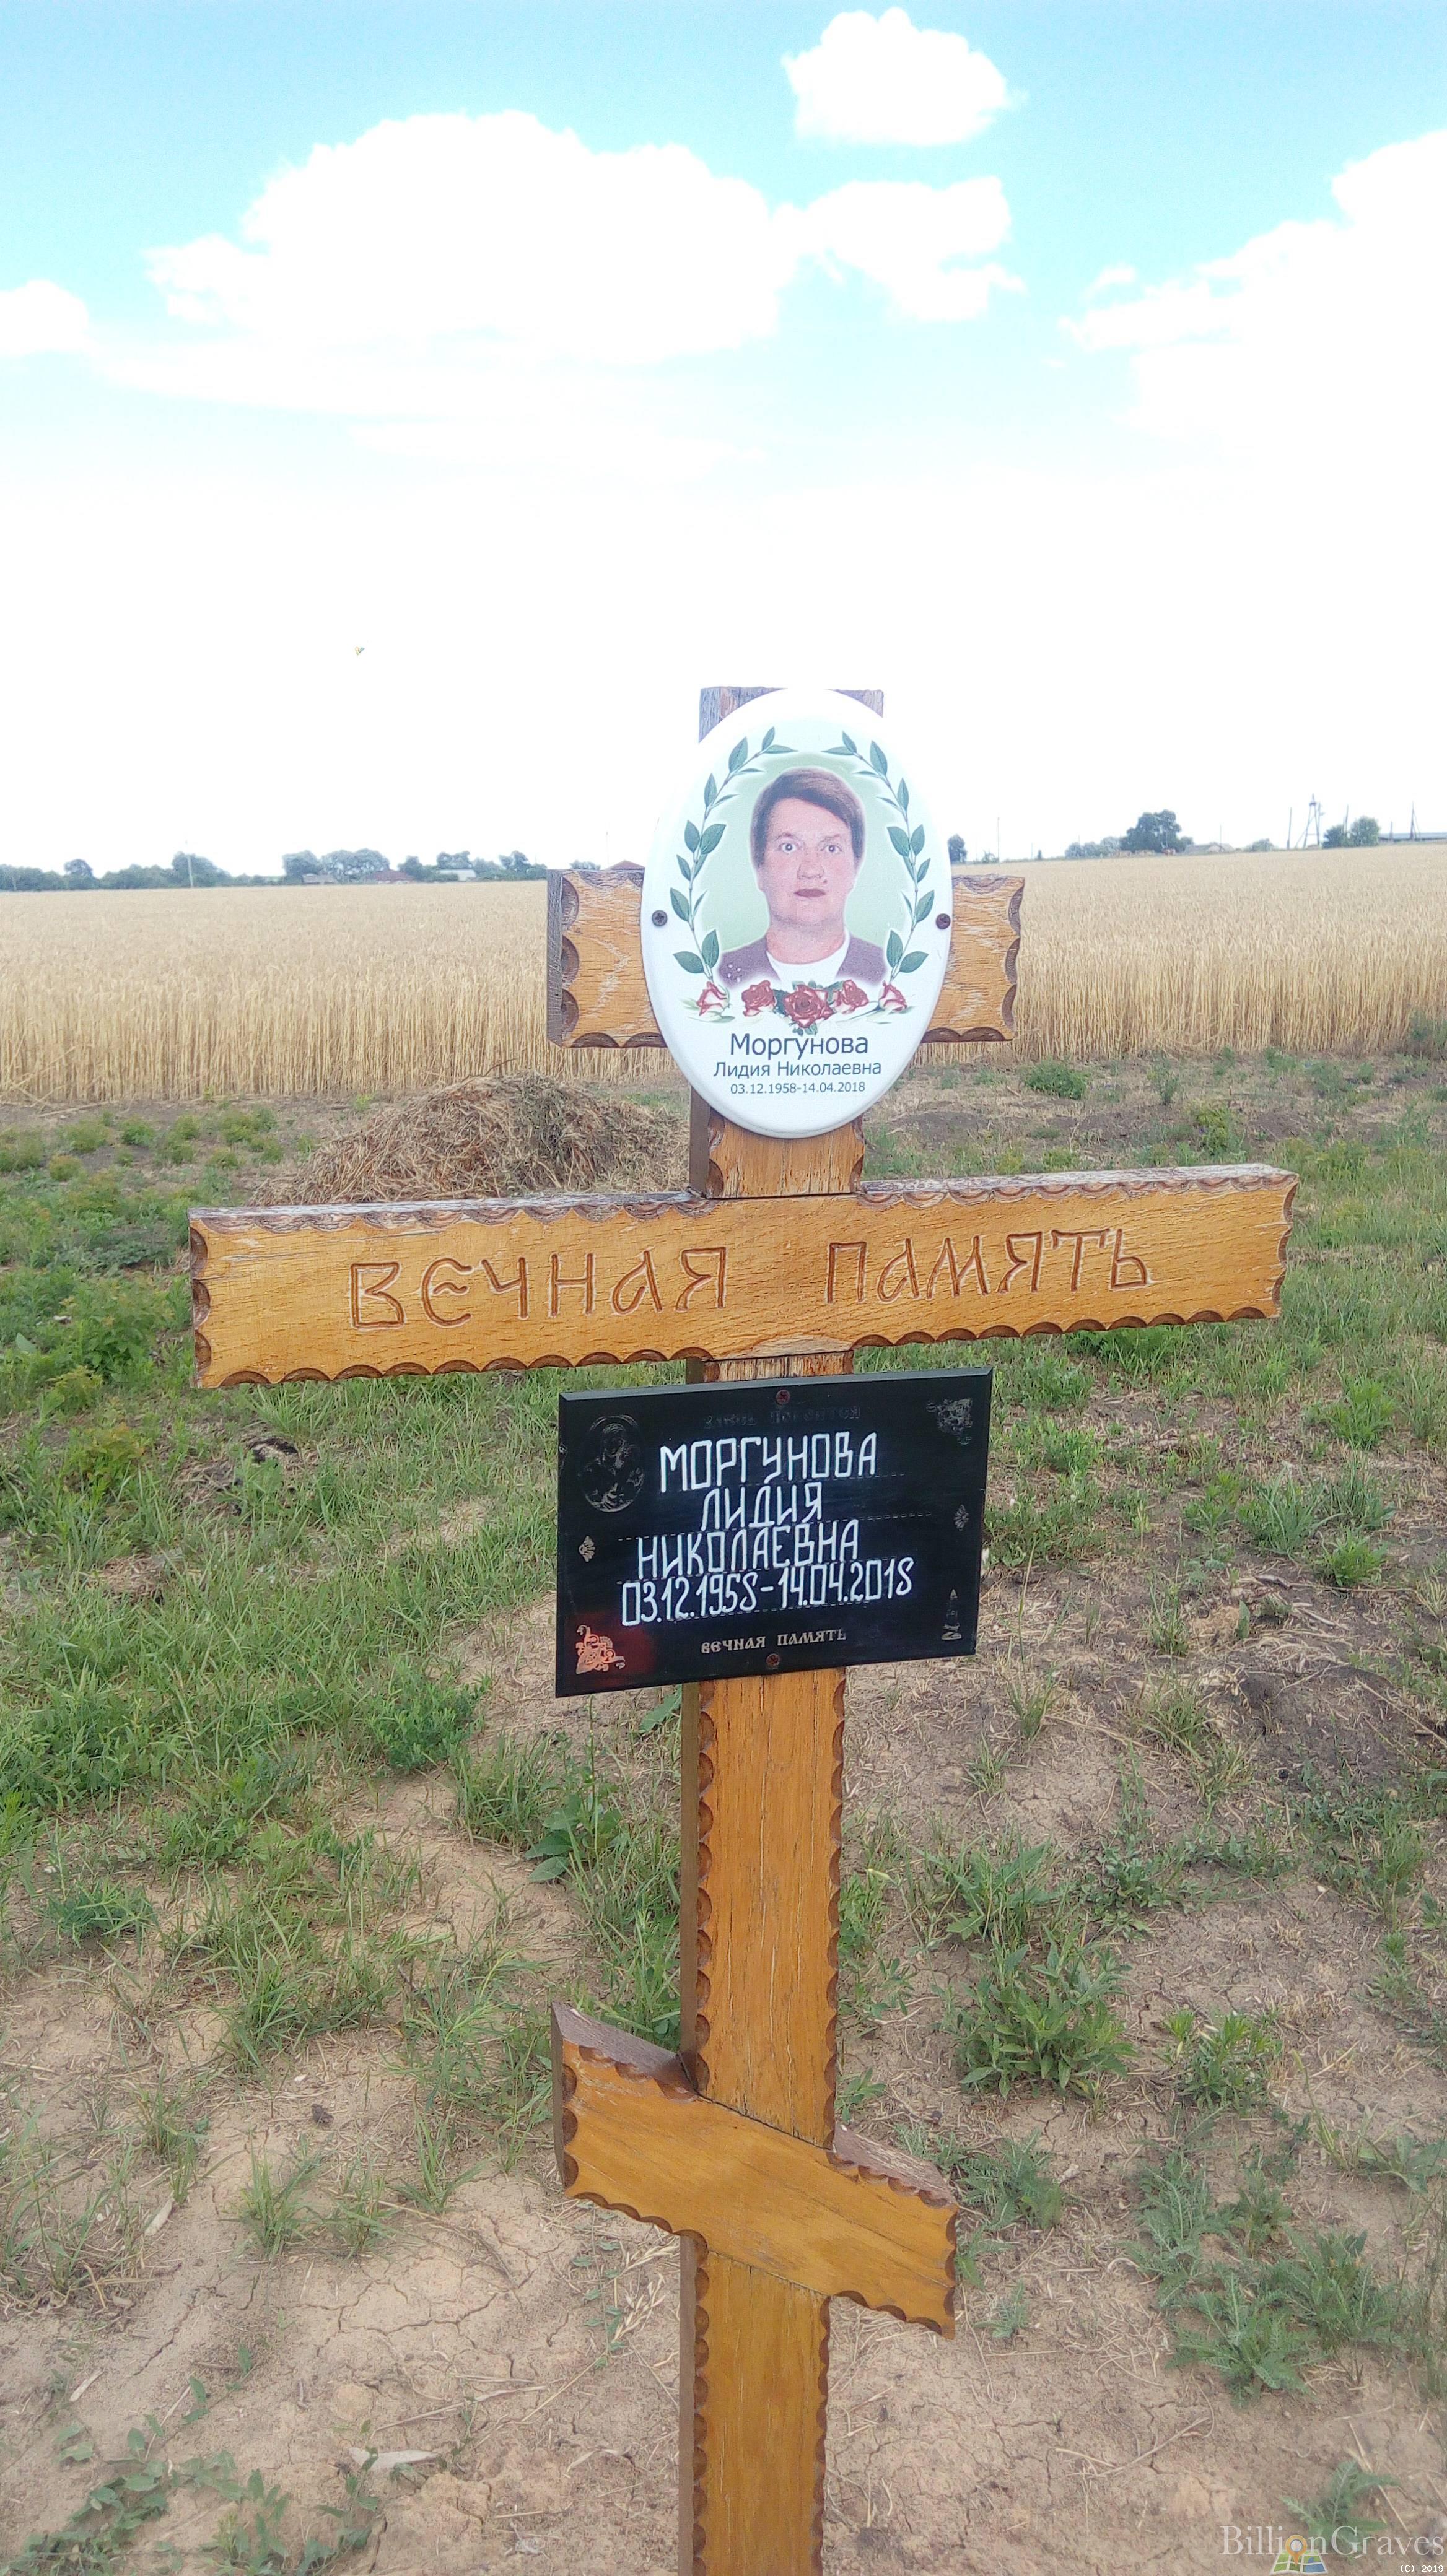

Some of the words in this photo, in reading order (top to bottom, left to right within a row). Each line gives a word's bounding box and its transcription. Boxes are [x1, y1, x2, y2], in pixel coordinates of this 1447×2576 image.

[730, 1033, 868, 1060] Моргунова
[713, 1062, 771, 1079] Лидия
[777, 1061, 882, 1076] Николаевна
[730, 1082, 866, 1095] 03.12.1958-14.04.2018
[349, 1245, 727, 1329] ВЕЧНАЯ
[826, 1228, 1153, 1303] ПАМЯТЬ
[660, 1432, 878, 1492] МОРГУНОВА
[701, 1482, 823, 1531] ЛИДИЯ
[637, 1520, 859, 1580] НИКОЛАЕВНА
[701, 1635, 766, 1654] ВЕЧНАЯ
[777, 1629, 847, 1646] ПАМЯТЬ
